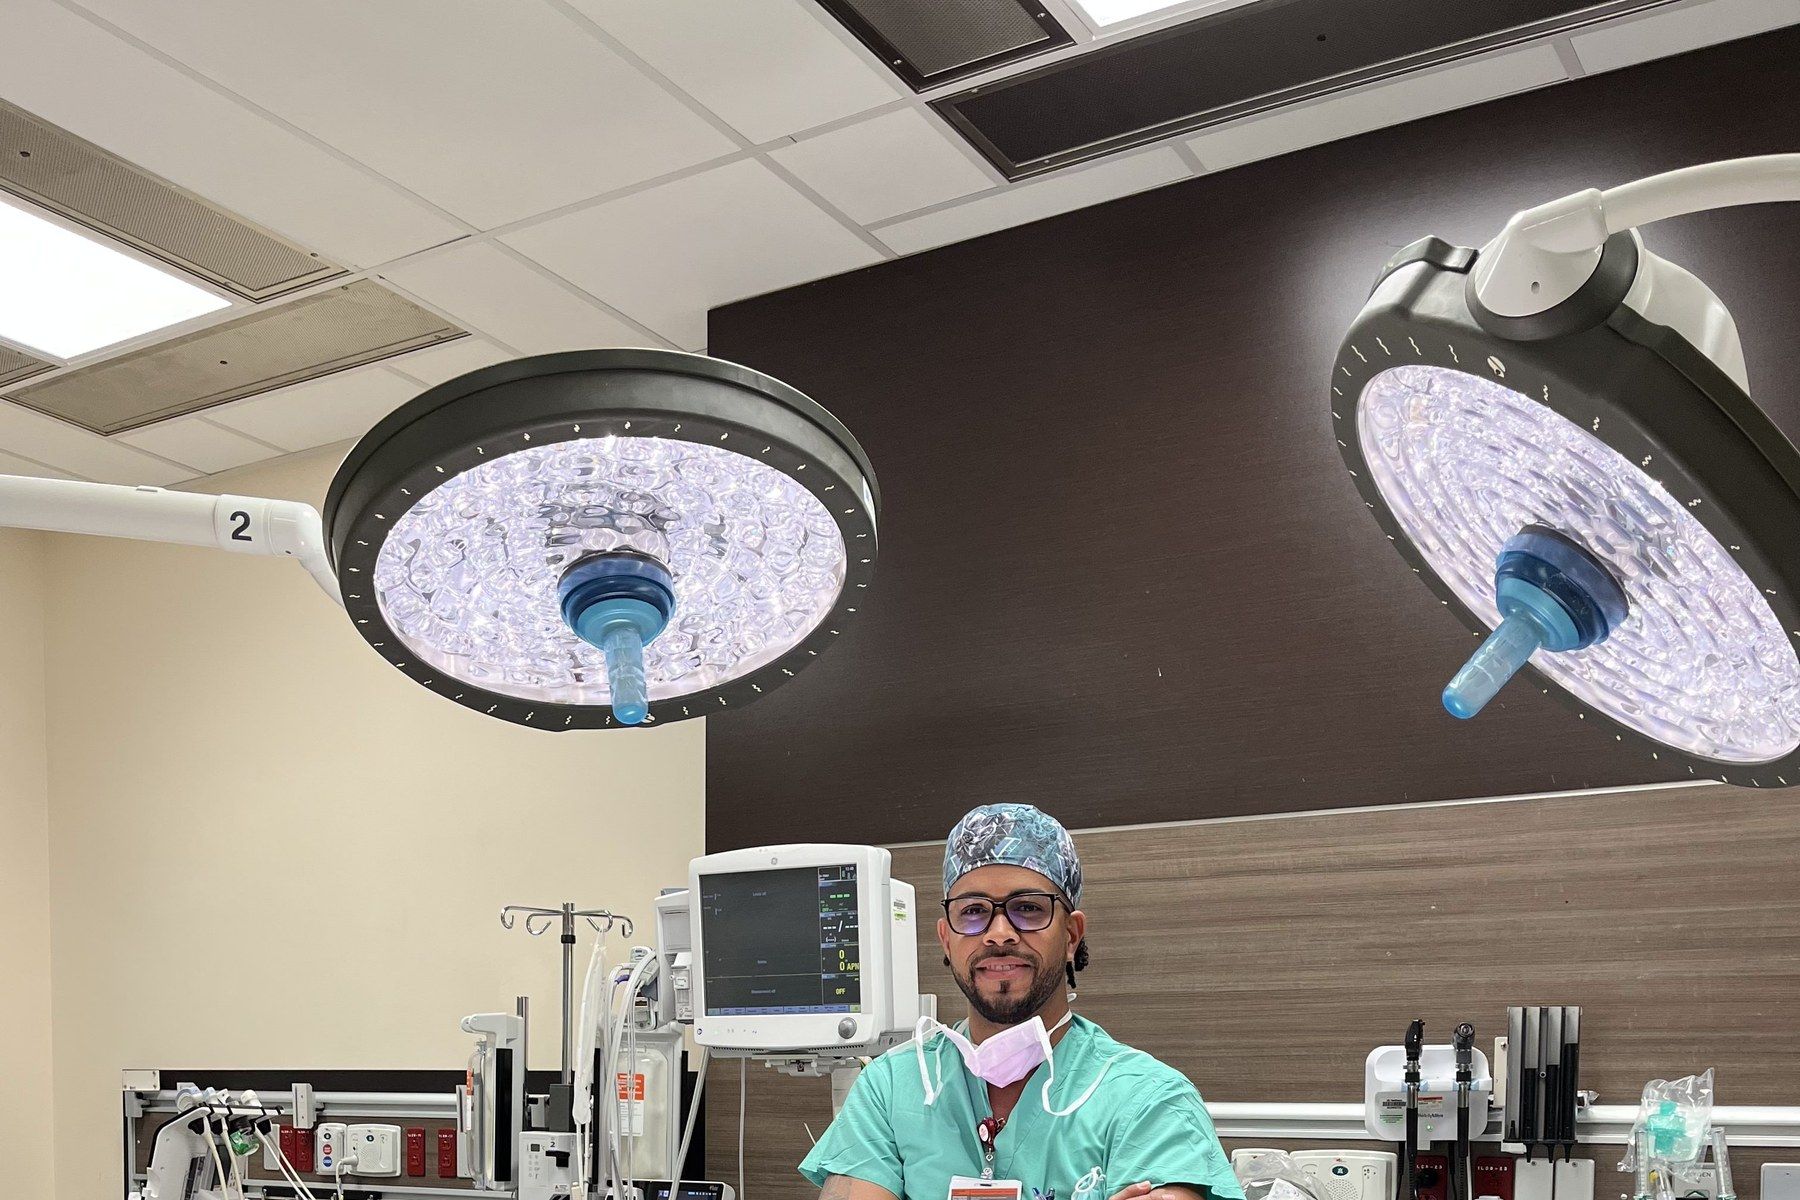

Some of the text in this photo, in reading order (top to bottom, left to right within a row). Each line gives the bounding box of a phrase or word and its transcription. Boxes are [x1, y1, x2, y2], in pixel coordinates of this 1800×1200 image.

[229, 510, 253, 541] 2
[839, 949, 845, 959] 0
[839, 961, 845, 971] 0
